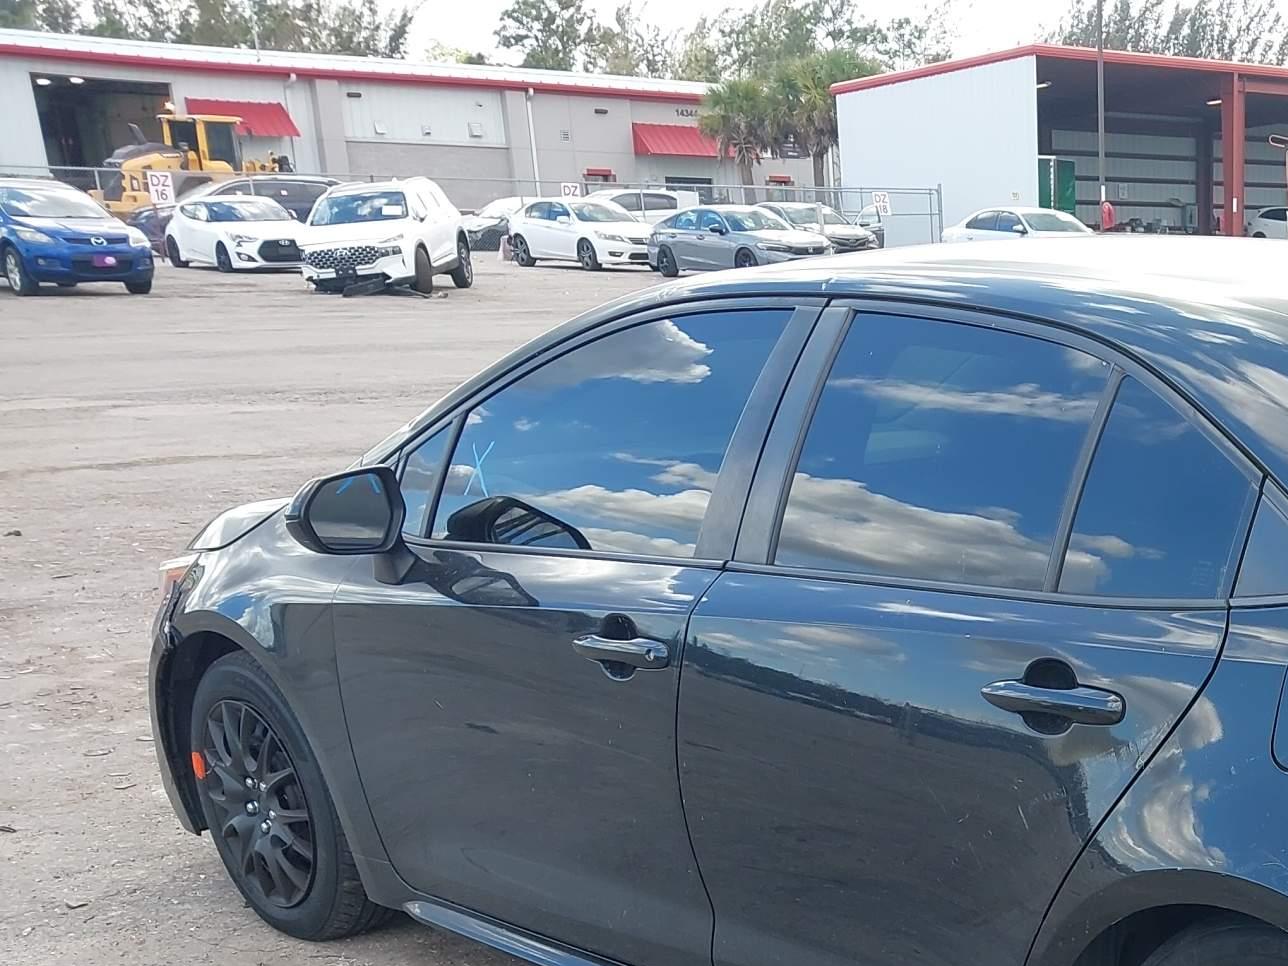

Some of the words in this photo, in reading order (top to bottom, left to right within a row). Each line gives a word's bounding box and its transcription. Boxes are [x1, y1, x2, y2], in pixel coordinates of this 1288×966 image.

[150, 174, 171, 188] DZ
[155, 189, 168, 201] 16
[563, 184, 578, 197] DZ
[874, 193, 888, 204] DZ
[878, 204, 889, 214] 18
